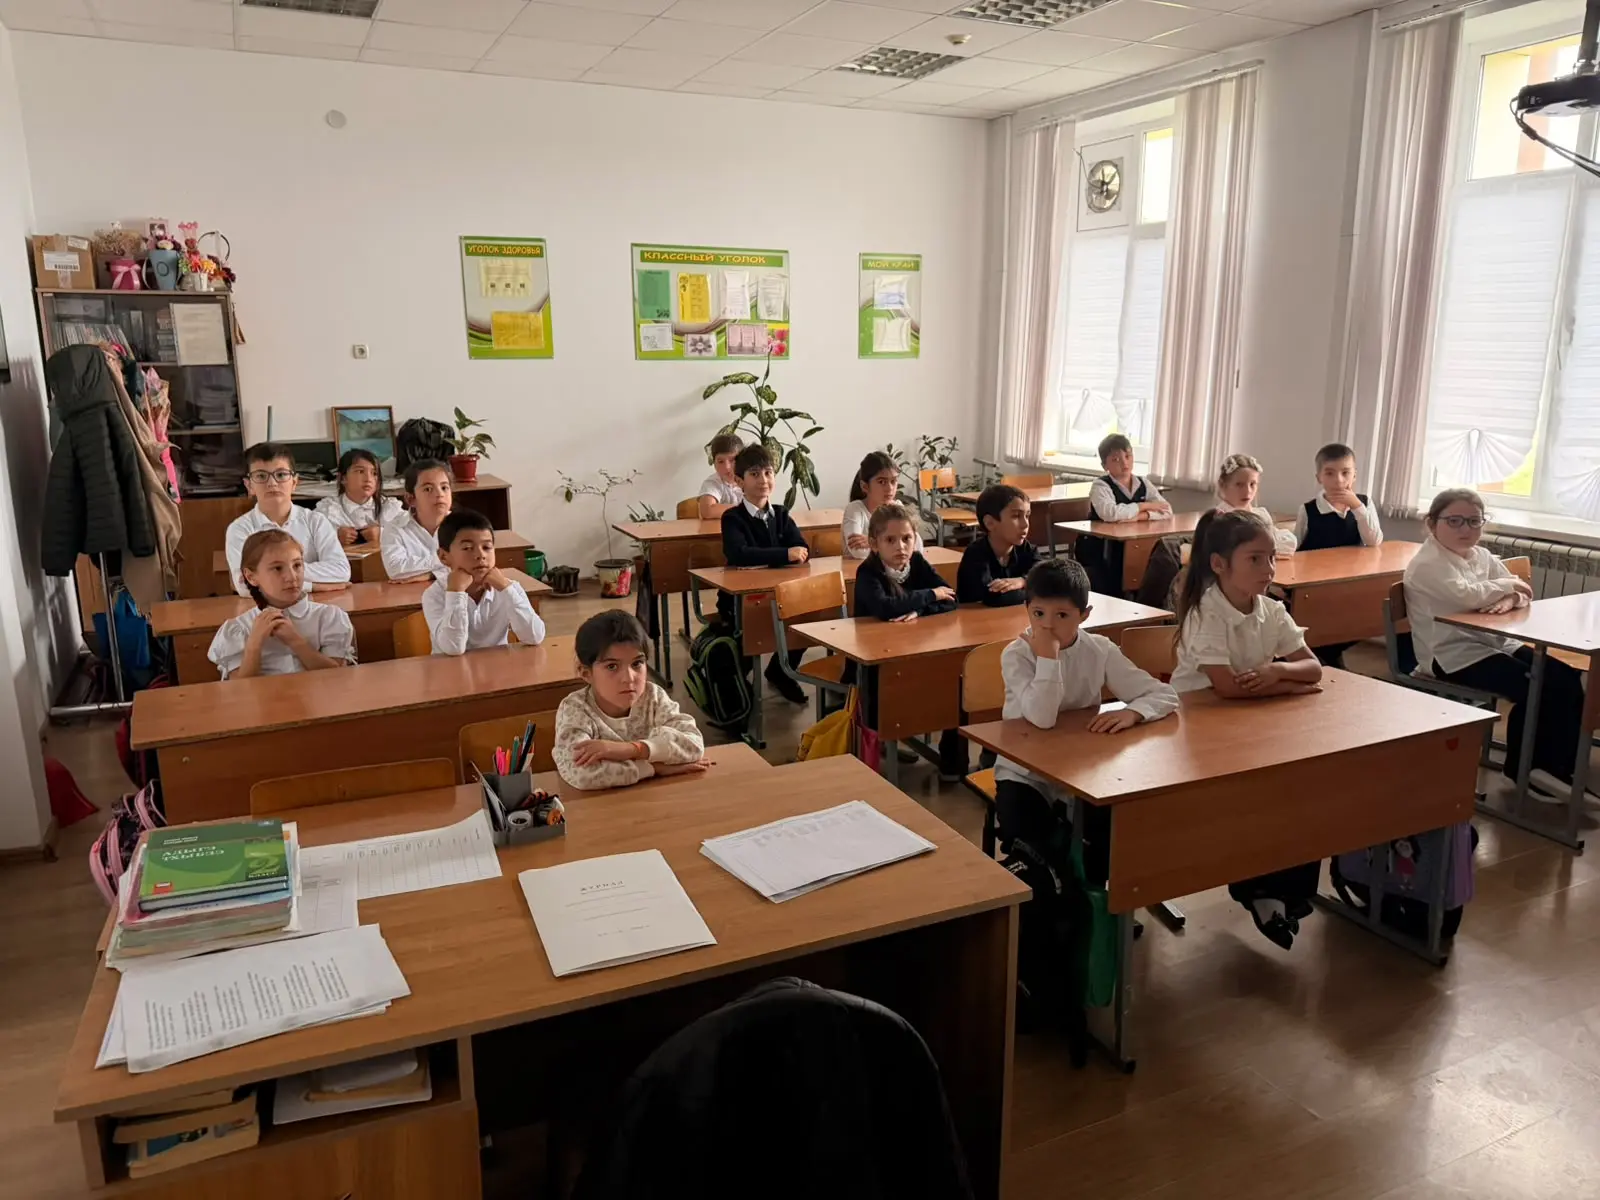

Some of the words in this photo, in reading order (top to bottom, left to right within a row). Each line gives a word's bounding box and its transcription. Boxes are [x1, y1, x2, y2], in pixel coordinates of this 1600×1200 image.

[467, 244, 499, 254] УГОЛОК
[502, 246, 541, 255] ЗДОРОВЬЯ
[643, 251, 714, 262] КЛАССНЫЙ
[719, 255, 766, 264] УГОЛОК
